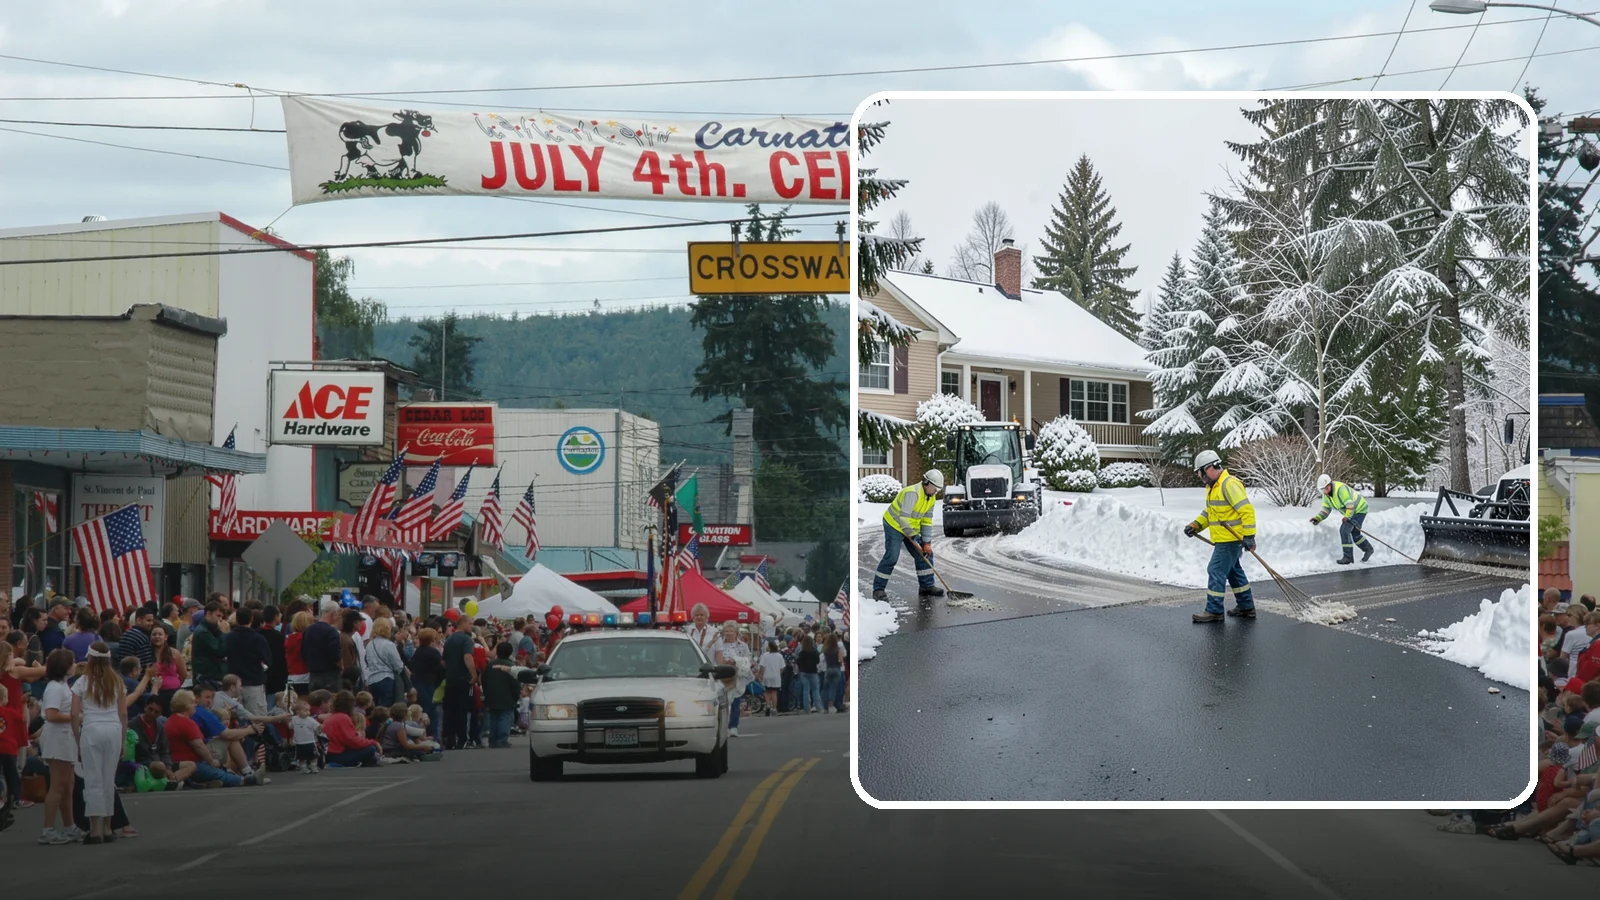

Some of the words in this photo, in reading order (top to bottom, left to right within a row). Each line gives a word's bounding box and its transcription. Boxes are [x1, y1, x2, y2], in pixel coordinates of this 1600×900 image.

[695, 121, 850, 150] Carnat
[481, 141, 605, 193] JULY
[632, 150, 746, 198] 4th.
[697, 254, 850, 280] CROSSWA
[283, 380, 374, 420] ACE
[406, 409, 453, 422] CEDAR
[283, 420, 371, 437] Hardware
[416, 428, 477, 447] Coca-Cola
[354, 467, 385, 480] Simpl
[83, 486, 93, 494] St.
[95, 485, 124, 495] Vincent
[126, 486, 136, 495] de
[137, 486, 155, 496] Paul
[688, 526, 742, 535] CRNATION
[699, 535, 730, 543] GLASS
